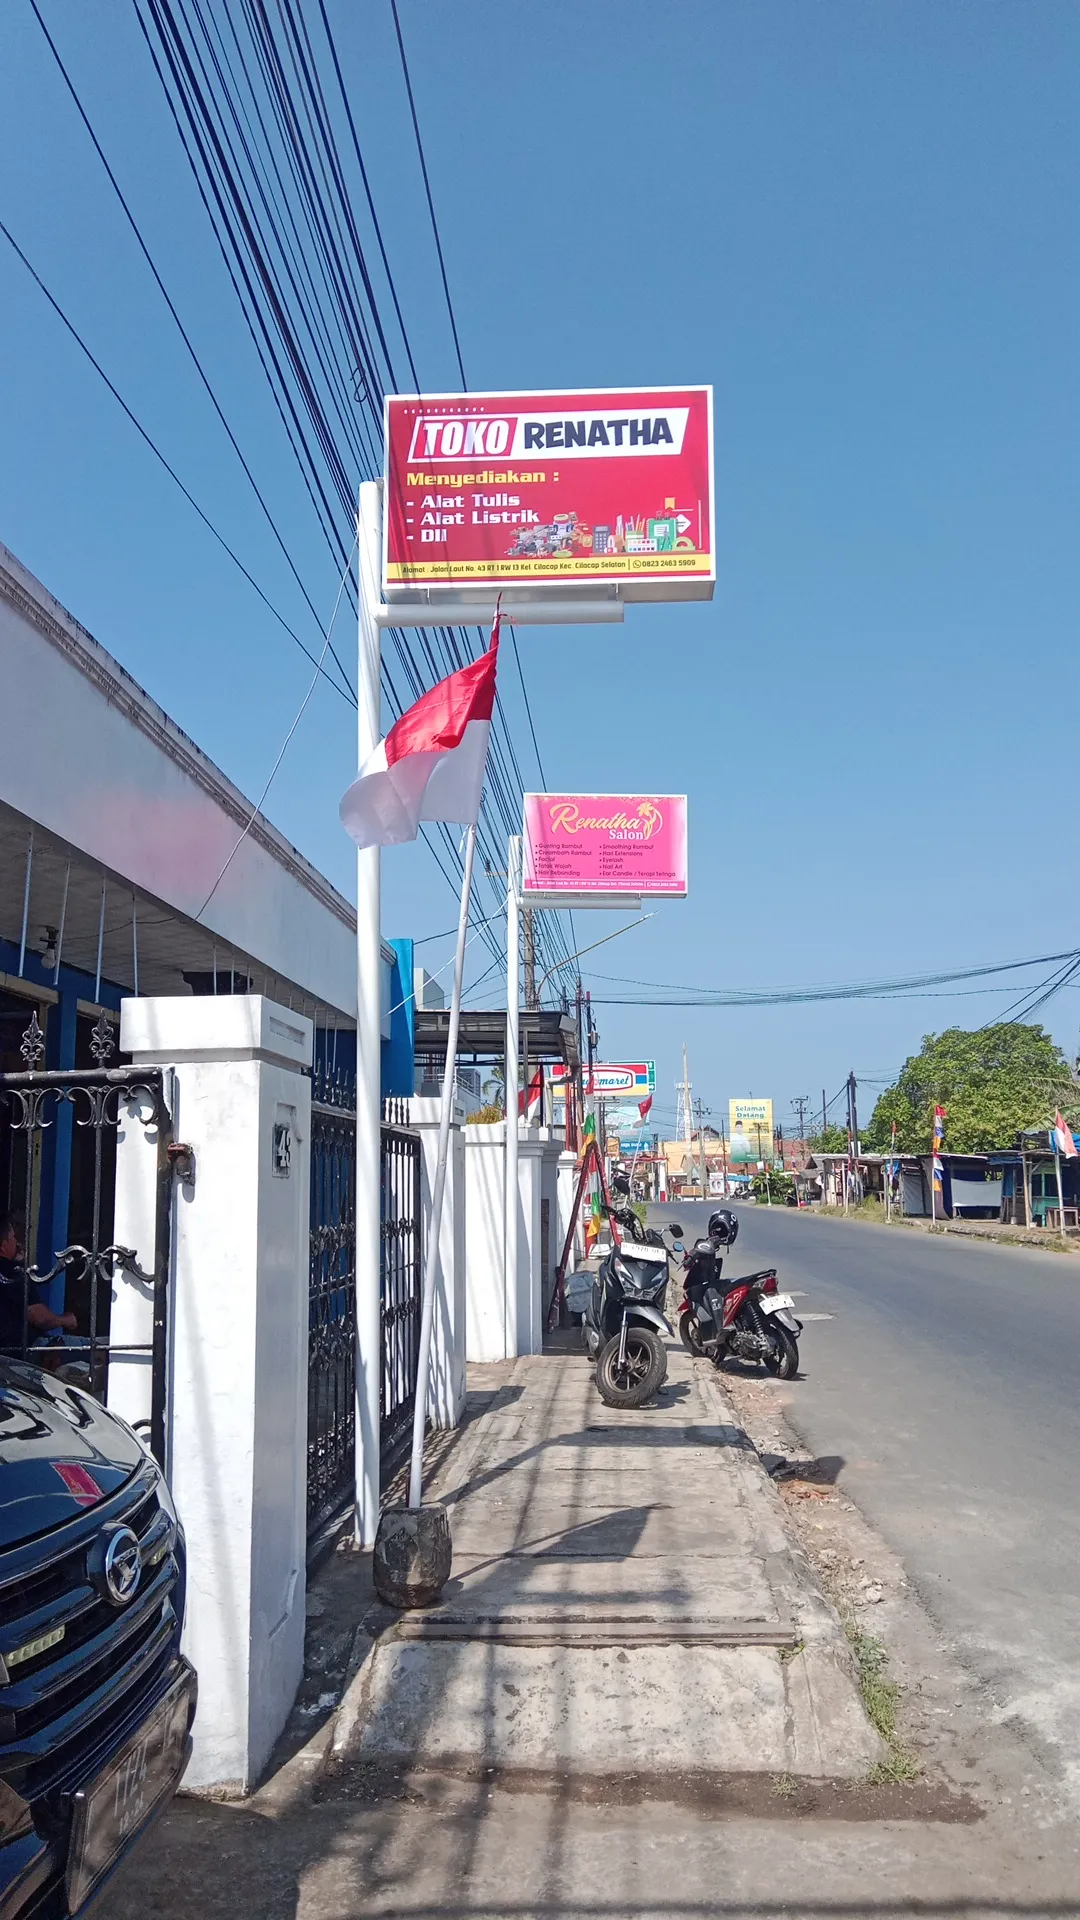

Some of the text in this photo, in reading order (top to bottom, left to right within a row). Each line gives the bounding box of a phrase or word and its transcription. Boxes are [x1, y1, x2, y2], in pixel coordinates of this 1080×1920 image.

[423, 418, 673, 456] TOKO RENATHA
[407, 470, 545, 488] Menyediakan
[420, 494, 464, 508] Alat
[472, 493, 520, 507] Tulis
[420, 512, 464, 526] Alat
[472, 510, 540, 524] Listrik
[550, 803, 642, 834] Renatha
[609, 830, 644, 840] Salon
